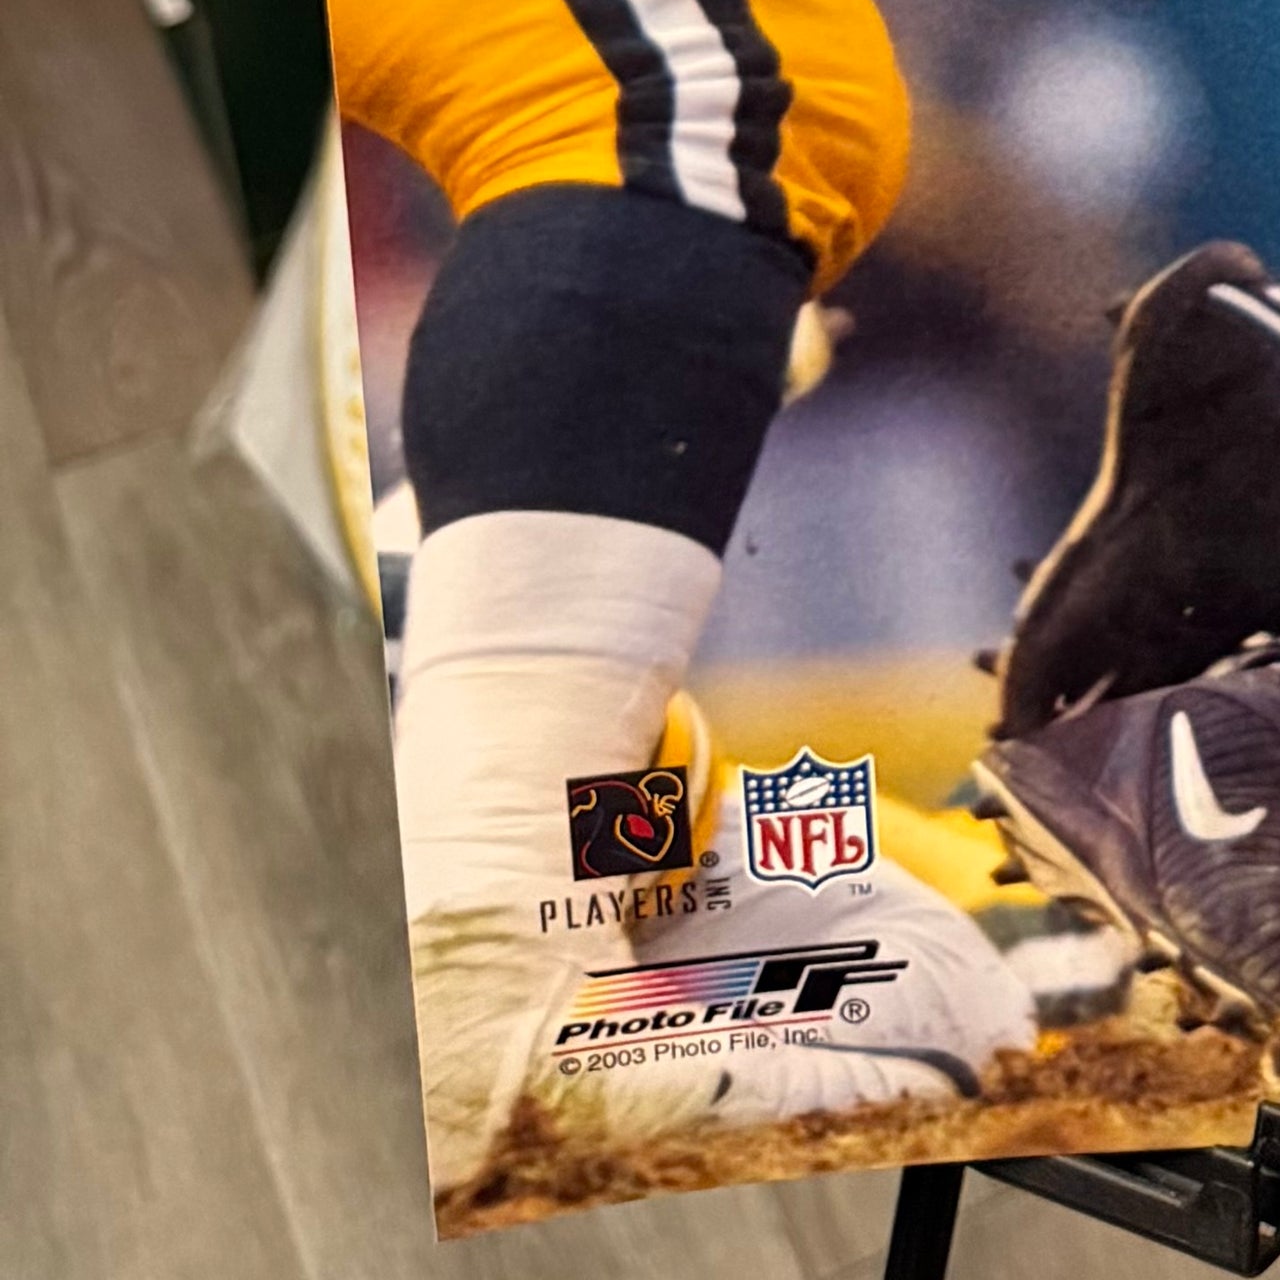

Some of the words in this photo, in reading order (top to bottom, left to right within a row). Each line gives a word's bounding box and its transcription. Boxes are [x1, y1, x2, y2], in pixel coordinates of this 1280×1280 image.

[756, 806, 866, 876] NFL
[539, 880, 699, 934] PLAYERS
[705, 876, 733, 911] INC
[555, 1009, 696, 1046] Photo
[701, 999, 786, 1024] File
[587, 1046, 647, 1073] 2003
[654, 1037, 722, 1062] Photo
[729, 1031, 777, 1052] File,
[784, 1027, 826, 1044] Inc.
